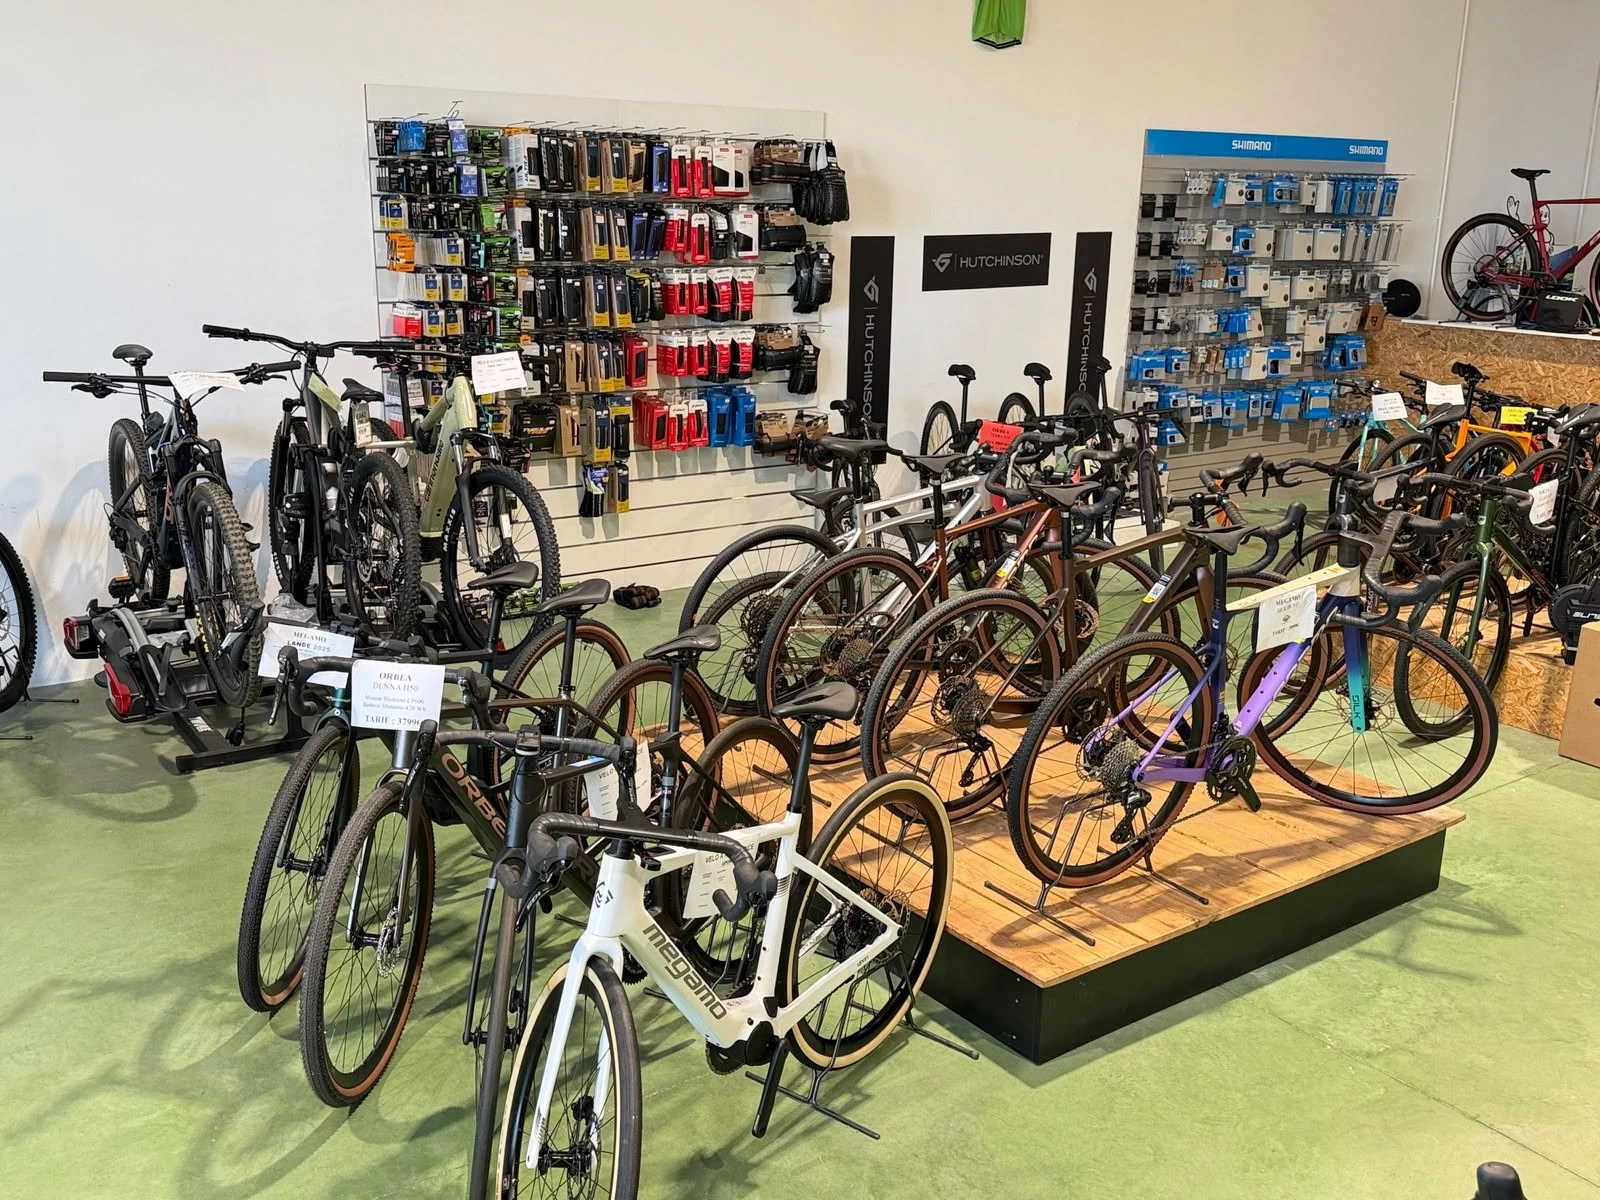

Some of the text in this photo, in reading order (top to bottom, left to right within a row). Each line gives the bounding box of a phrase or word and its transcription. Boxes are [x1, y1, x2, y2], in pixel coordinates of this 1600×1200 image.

[1231, 139, 1272, 152] SHIMANO
[1348, 144, 1384, 156] SHIMANO
[959, 254, 1042, 268] HUTCHINSON
[1545, 294, 1578, 303] LOOK
[1079, 303, 1093, 392] HUTCHINSO
[863, 314, 875, 420] HUTCHINSO
[424, 441, 444, 503] cannondale
[442, 508, 456, 553] MAXXIS
[1275, 594, 1301, 606] MEGAMO
[293, 631, 327, 643] MEGAMO
[287, 640, 331, 653] LANDE 2025
[379, 671, 412, 682] ORBEA
[373, 682, 401, 691] DENNA
[1351, 694, 1361, 719] SILK
[364, 715, 390, 724] TARIF
[441, 752, 506, 840] ORBE
[705, 854, 720, 864] VELO
[642, 923, 728, 1021] megamo
